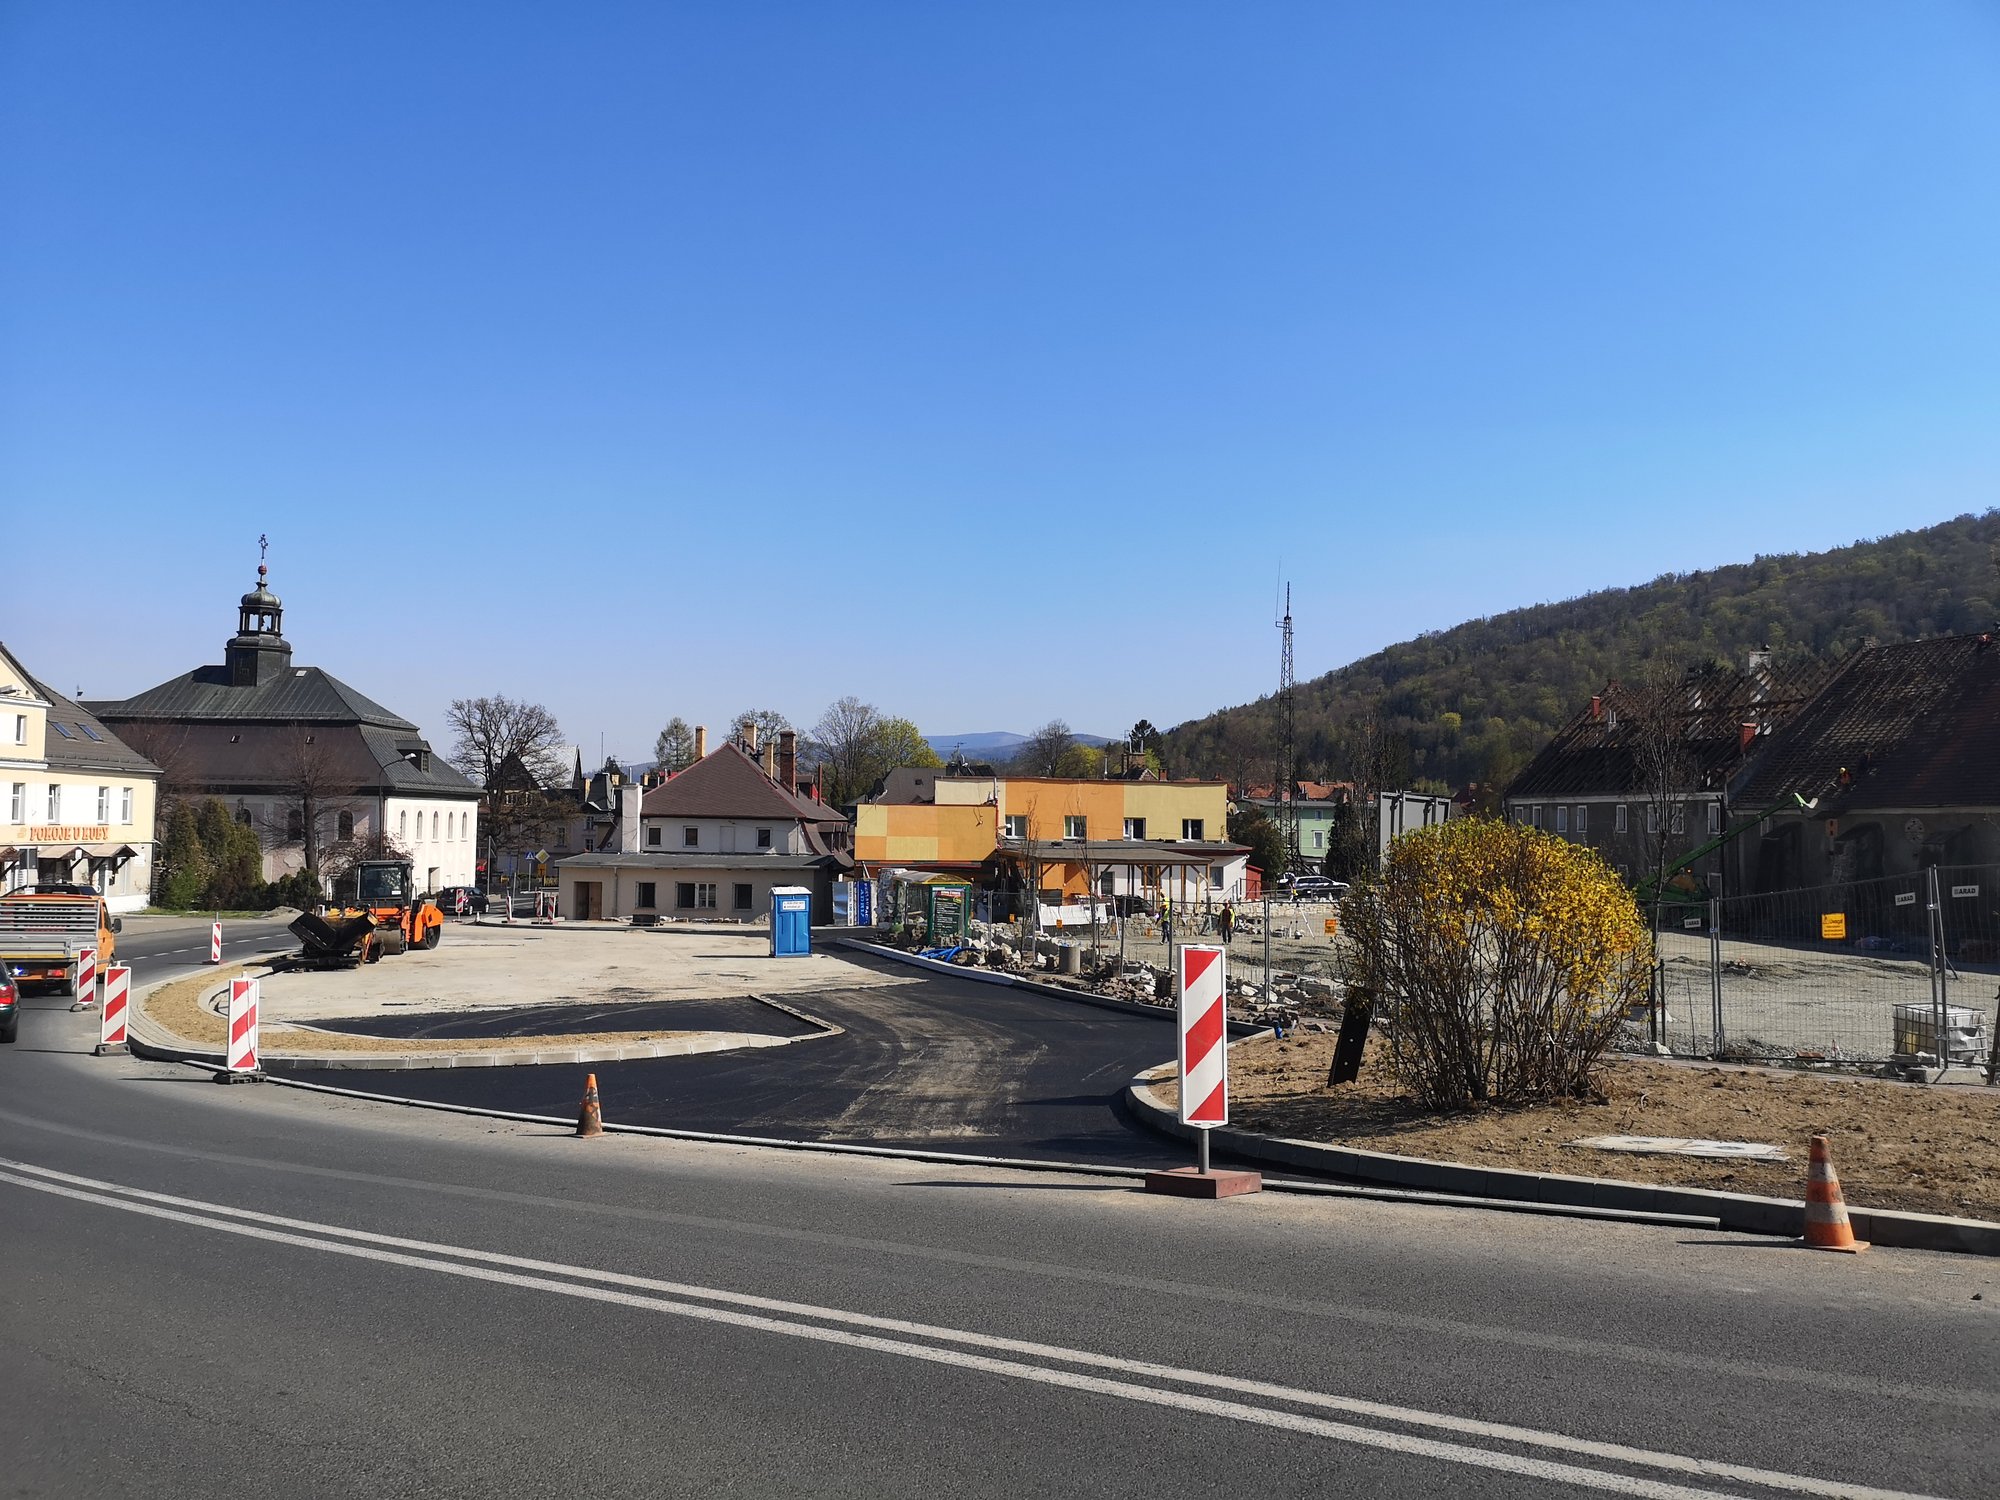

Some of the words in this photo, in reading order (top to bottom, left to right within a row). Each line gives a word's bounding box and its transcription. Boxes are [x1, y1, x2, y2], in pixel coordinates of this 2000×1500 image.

[29, 827, 71, 841] POKOJE
[73, 827, 81, 840] U
[81, 826, 109, 840] KUBY
